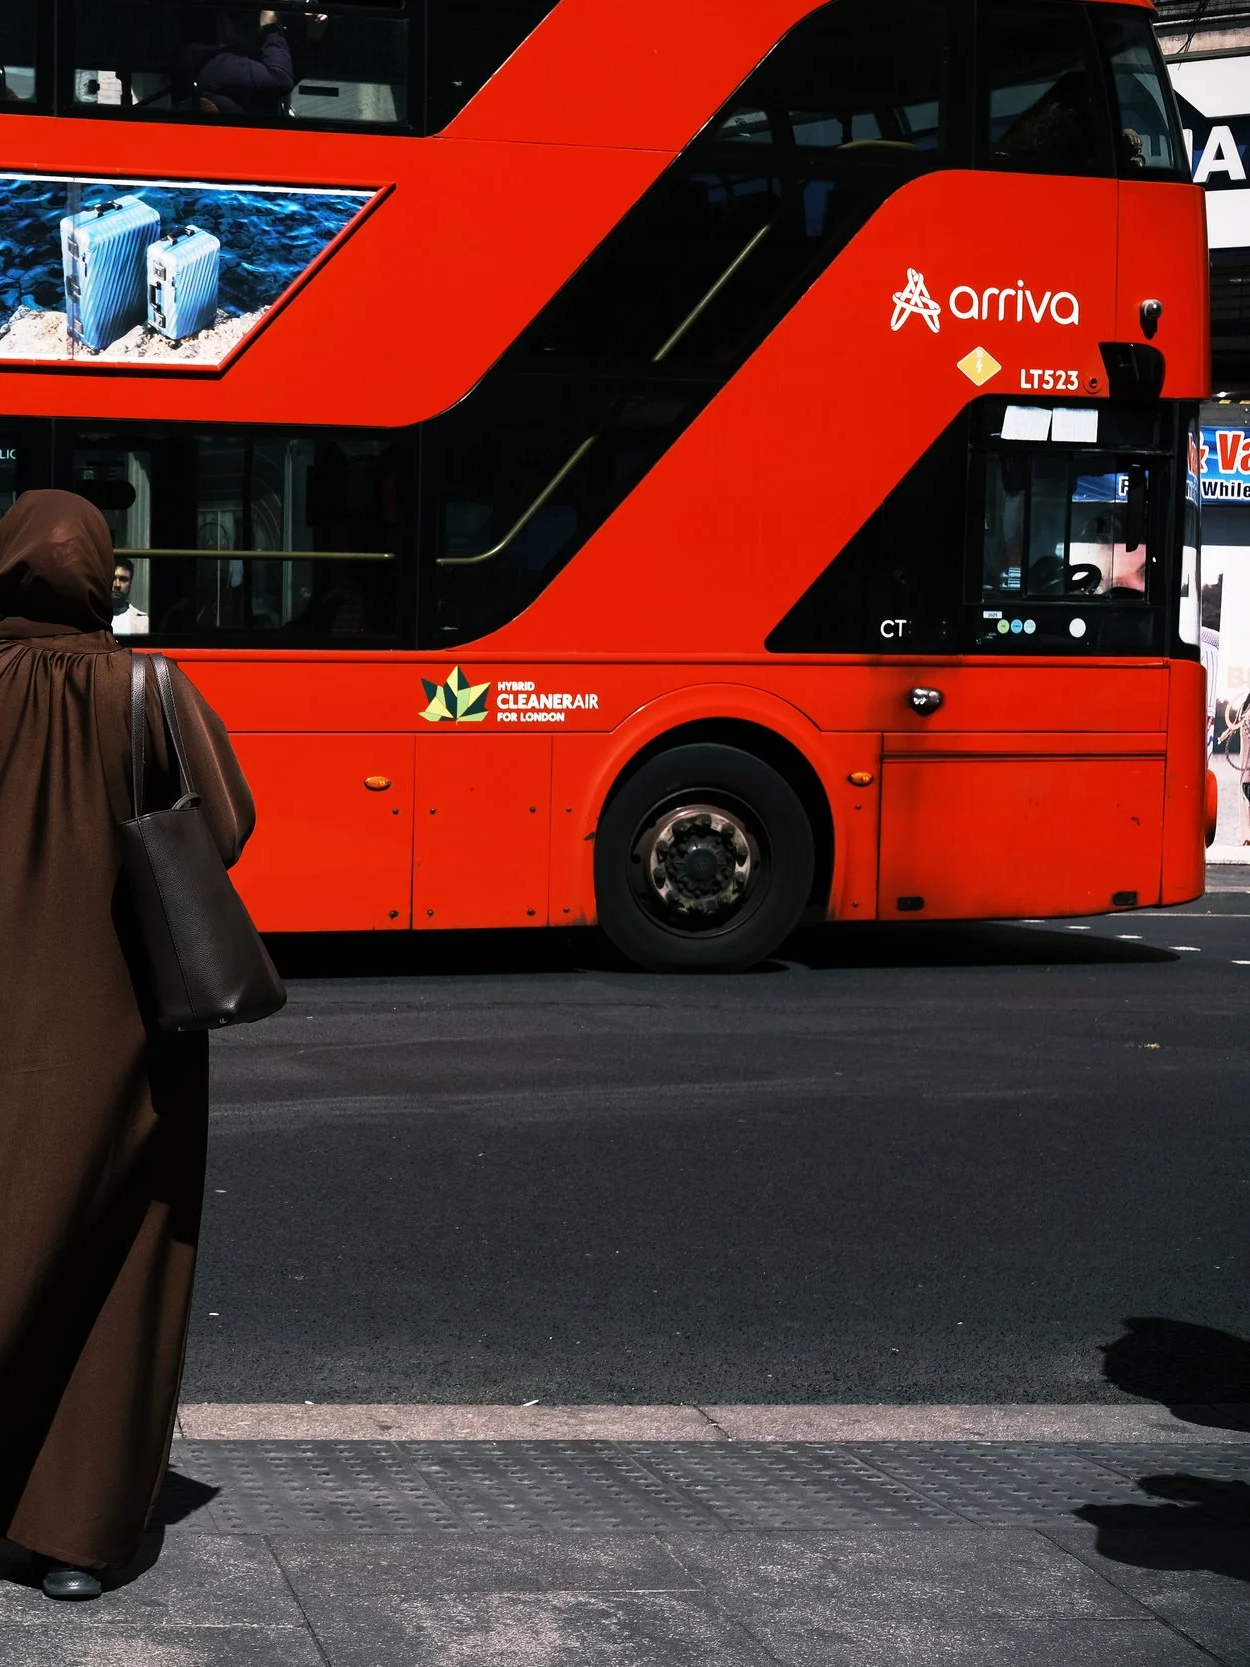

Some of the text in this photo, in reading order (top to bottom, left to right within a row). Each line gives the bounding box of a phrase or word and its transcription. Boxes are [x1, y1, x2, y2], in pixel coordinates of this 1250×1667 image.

[949, 280, 1079, 325] arriva
[1021, 368, 1079, 391] LT523
[880, 619, 907, 638] CT
[497, 681, 535, 691] HYBRID
[497, 712, 565, 722] FOR LONDON
